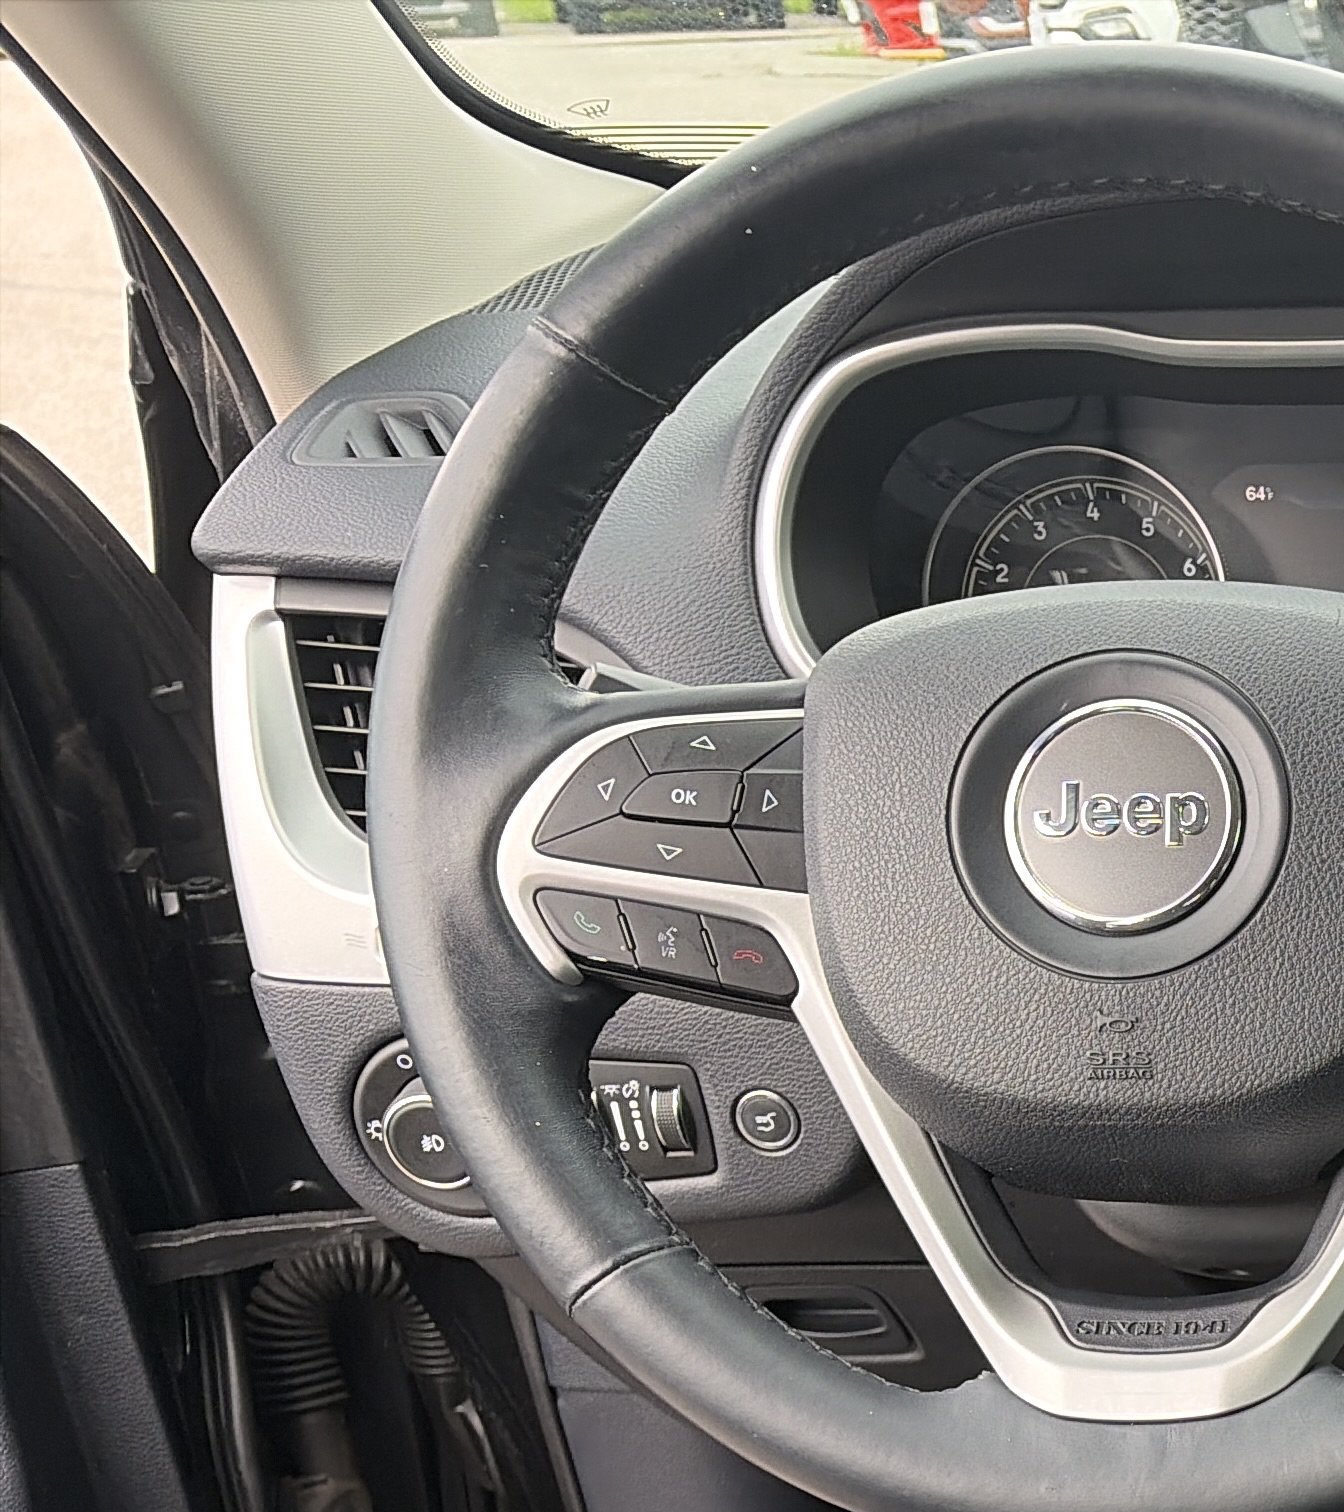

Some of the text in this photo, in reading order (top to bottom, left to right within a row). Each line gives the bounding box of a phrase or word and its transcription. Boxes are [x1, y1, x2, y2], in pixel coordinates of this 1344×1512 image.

[1085, 502, 1100, 521] 4
[1033, 521, 1047, 541] 3
[1141, 517, 1154, 536] 5
[995, 563, 1009, 583] 2
[1182, 558, 1196, 577] 6
[670, 787, 698, 806] OK
[1033, 779, 1210, 848] Jeep
[660, 944, 678, 961] VR
[1085, 1050, 1153, 1066] SRS
[1087, 1068, 1154, 1080] AIRBAG
[1075, 1318, 1231, 1337] SINCE 1941
